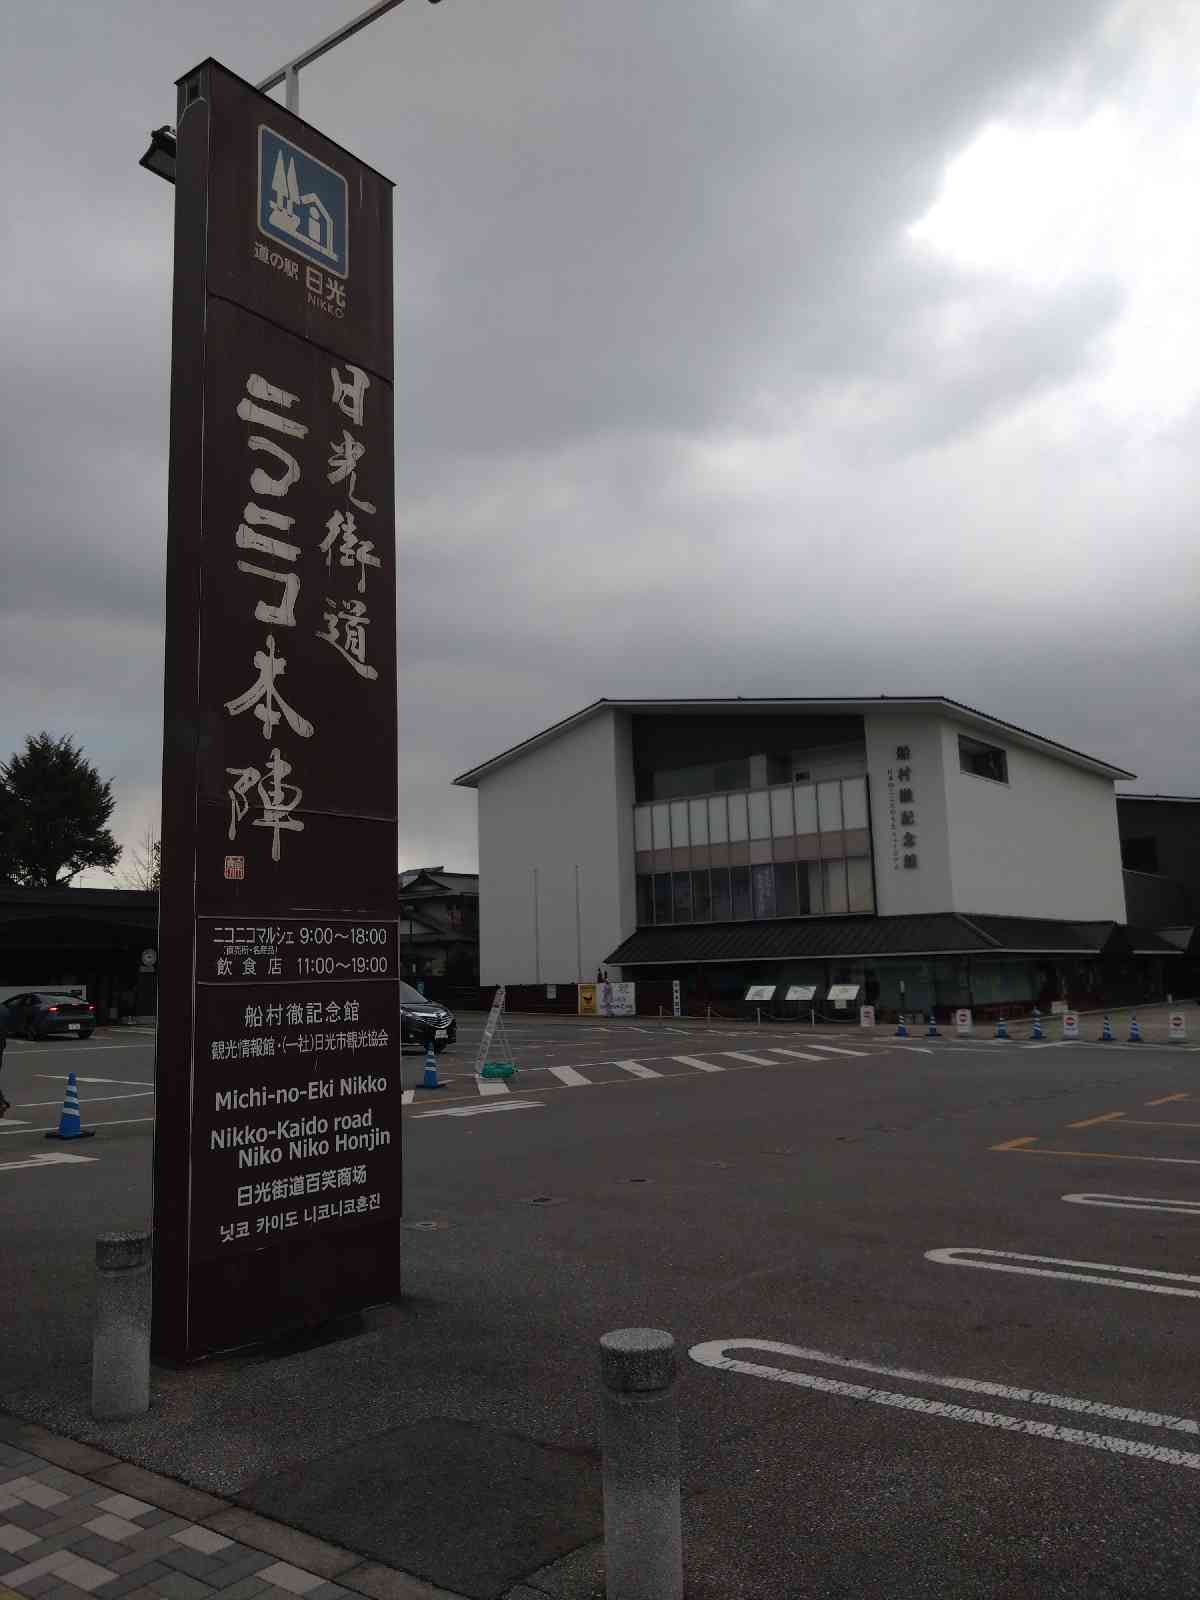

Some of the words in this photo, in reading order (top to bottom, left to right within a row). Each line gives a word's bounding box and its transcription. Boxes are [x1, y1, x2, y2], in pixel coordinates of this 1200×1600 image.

[253, 241, 299, 281] 道の駅
[305, 266, 346, 308] 日光
[306, 293, 345, 319] NIKKO
[315, 364, 381, 681] 日光街道
[213, 926, 295, 945] ニコニコマルシェ
[244, 1000, 360, 1028] 船村徹記念館
[215, 1079, 334, 1112] Michi-no-Eki
[340, 1075, 388, 1097] Nikko
[210, 1115, 329, 1150] Nikko-Kaido
[334, 1108, 373, 1131] road
[238, 1145, 283, 1169] Niko
[289, 1138, 330, 1161] Niko
[335, 1128, 391, 1153] Honjin
[219, 1221, 251, 1243] 닛코
[256, 1210, 300, 1234] 카이도
[304, 1193, 381, 1223] 니코니코혼진
